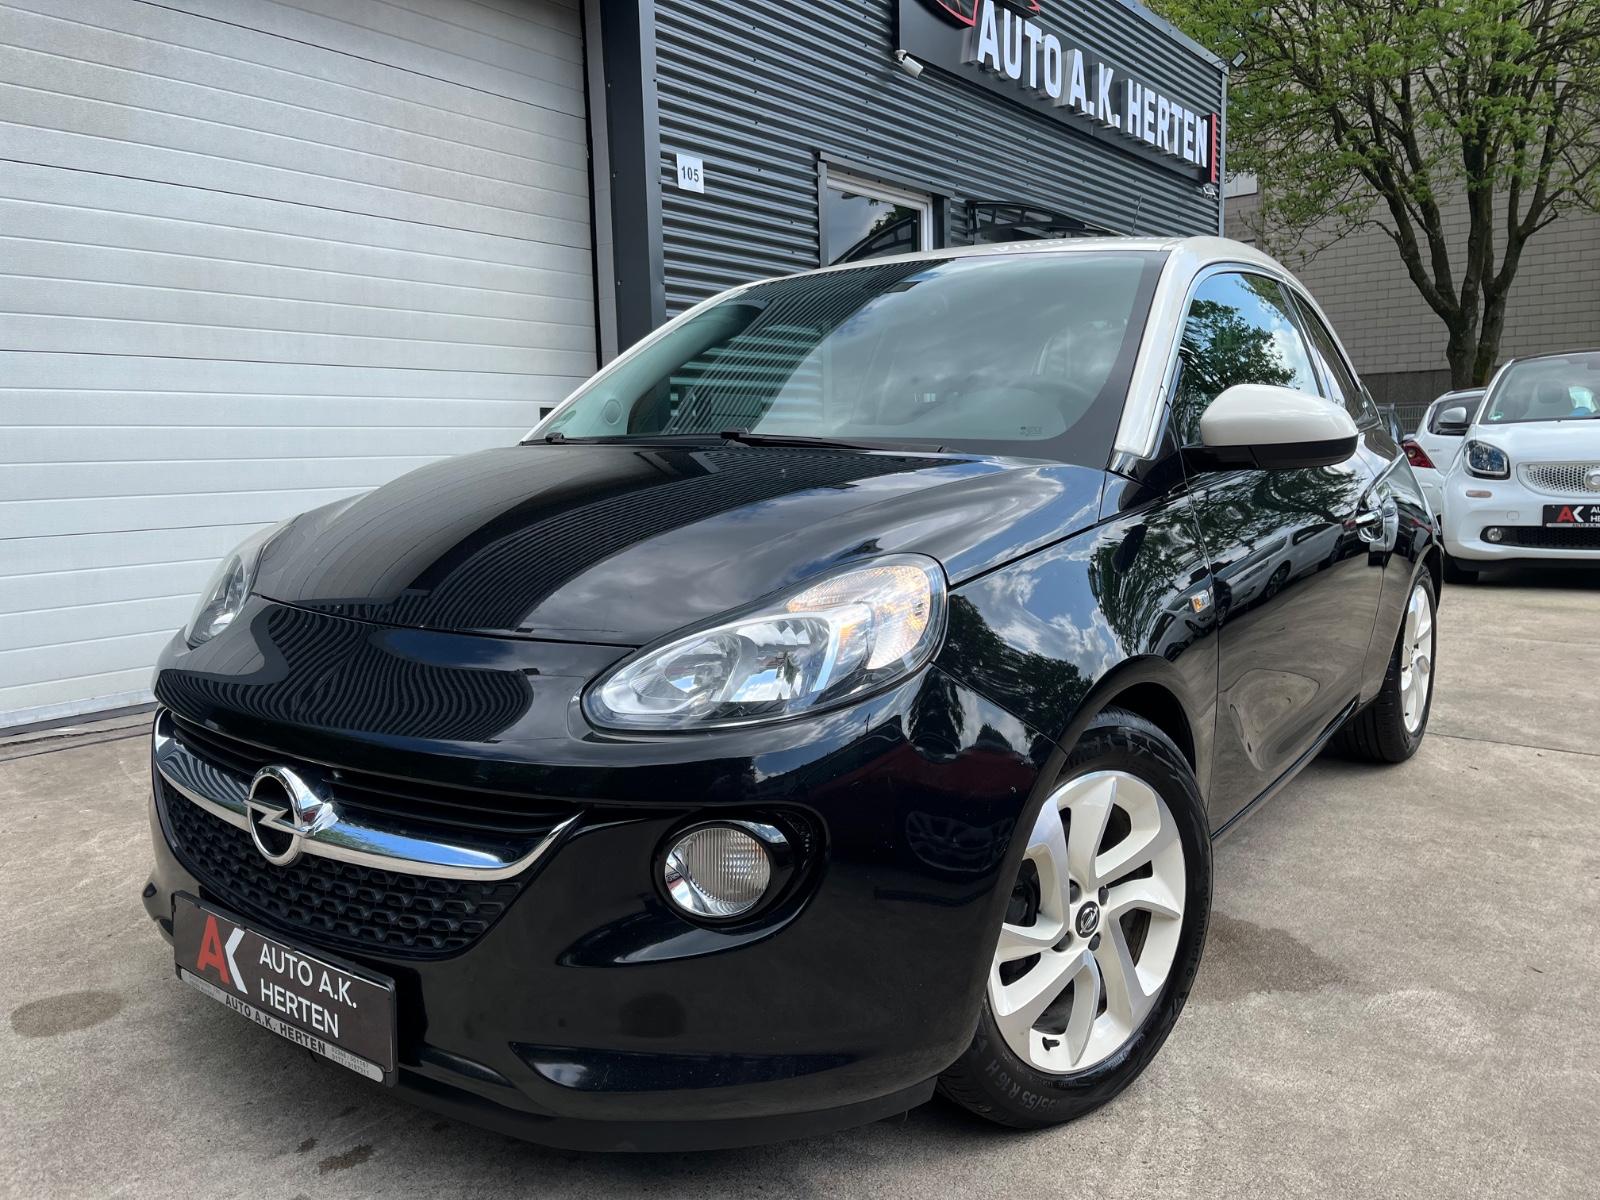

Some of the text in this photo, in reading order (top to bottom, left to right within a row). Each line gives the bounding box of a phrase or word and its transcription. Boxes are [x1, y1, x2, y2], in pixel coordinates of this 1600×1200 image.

[977, 0, 1208, 169] AUTO A.K. HERTEN
[682, 166, 699, 182] 105
[197, 914, 248, 994] AK
[259, 943, 357, 1009] AUTO A.K.
[225, 994, 326, 1055] AUTO A.K. HERTEN
[260, 978, 339, 1038] HERTEN
